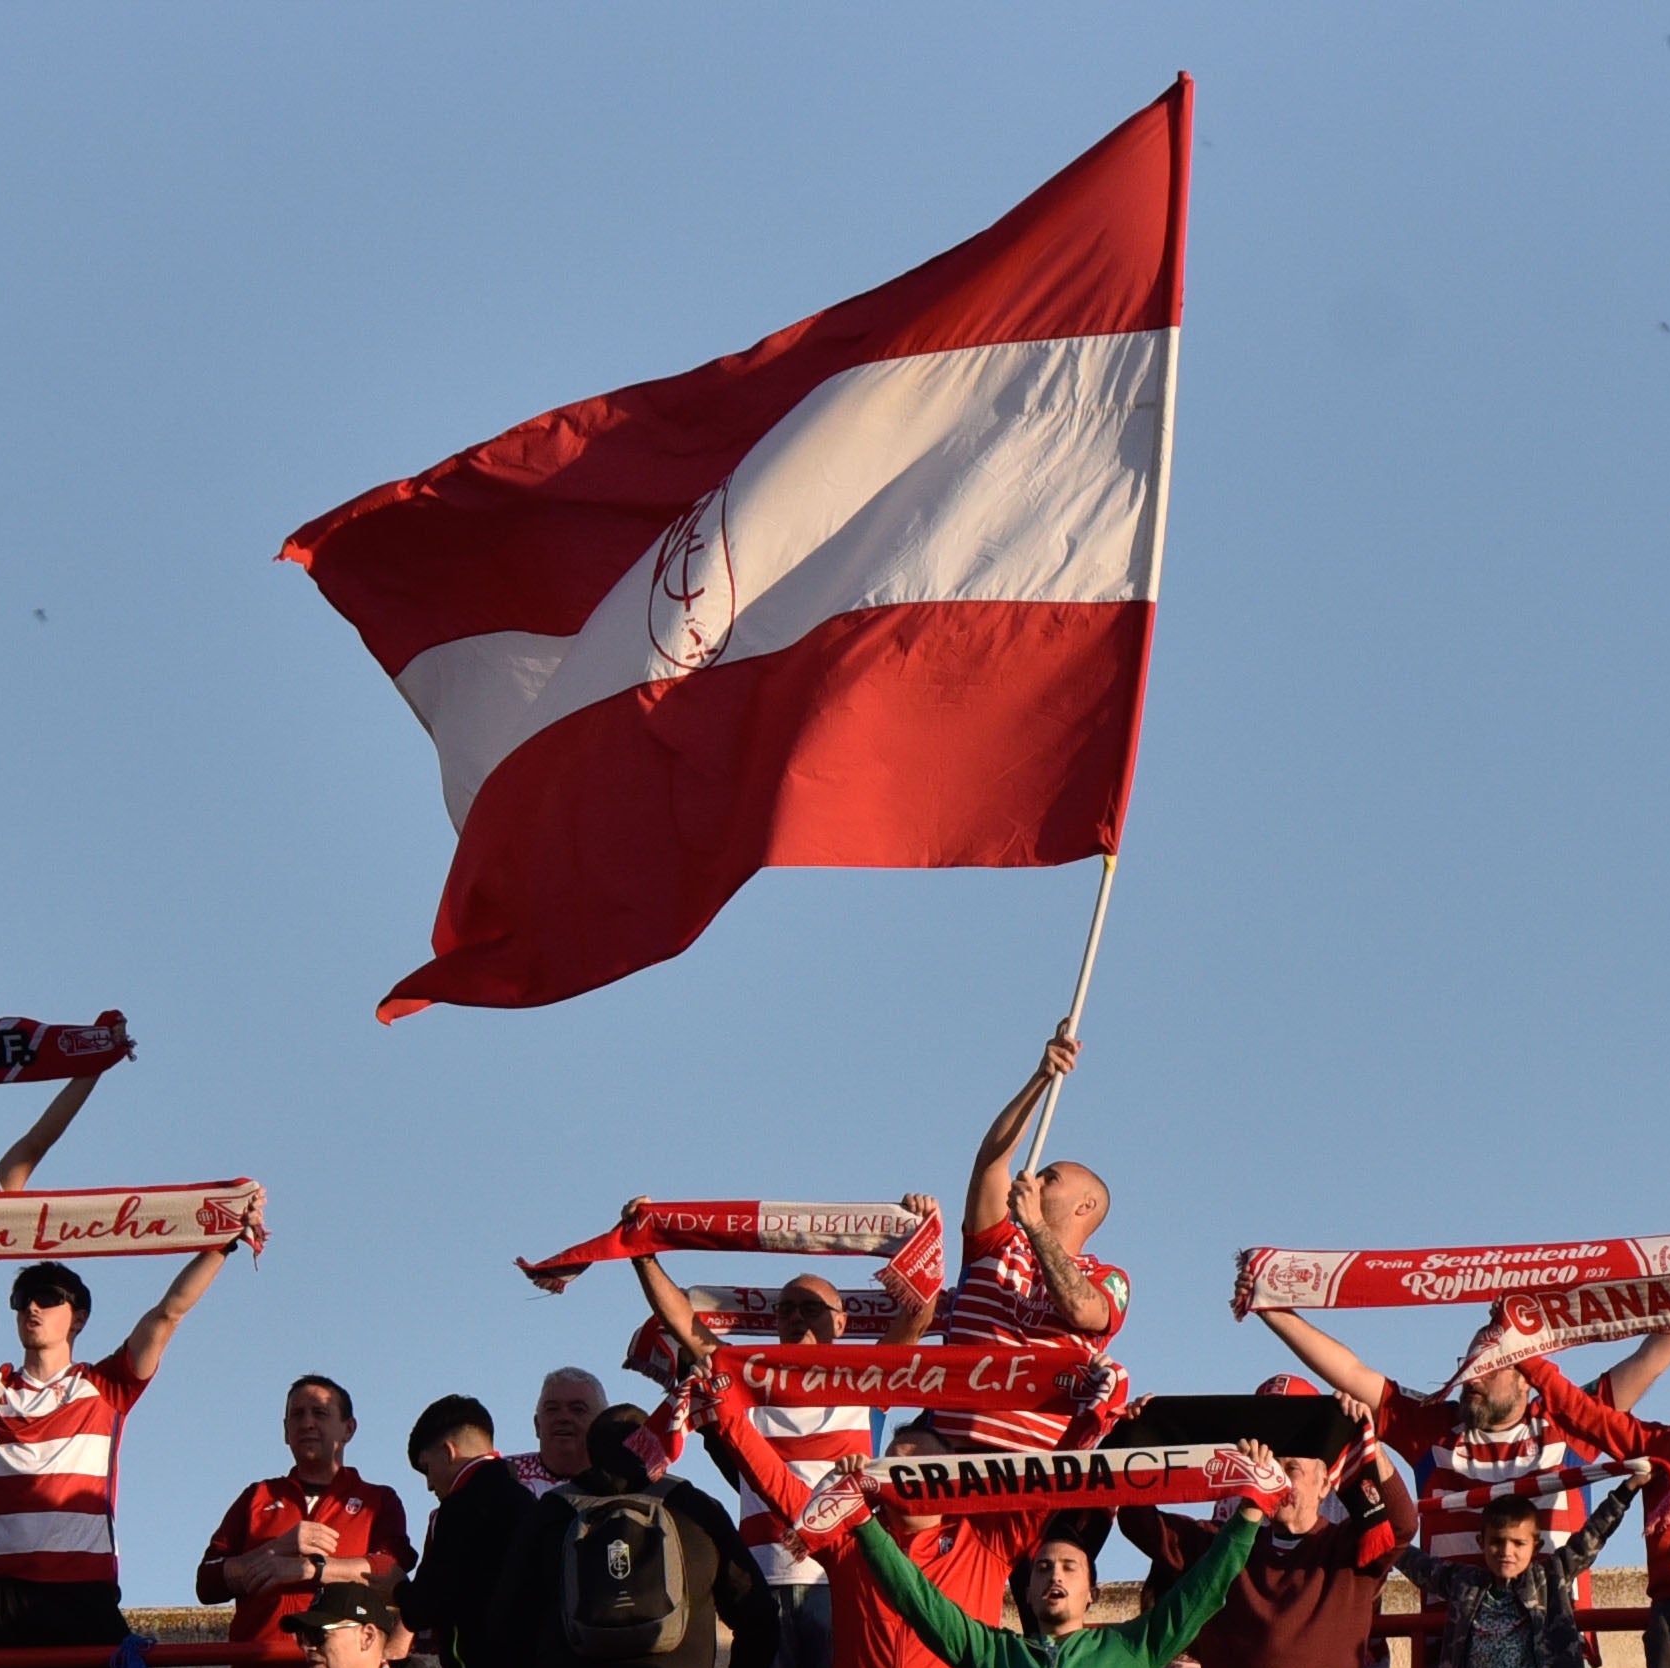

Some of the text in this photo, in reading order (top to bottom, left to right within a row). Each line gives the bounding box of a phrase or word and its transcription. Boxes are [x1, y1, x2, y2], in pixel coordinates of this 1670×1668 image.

[33, 1196, 178, 1250] Lucha
[1421, 1243, 1608, 1271] Sentimiento
[1401, 1264, 1579, 1300] Rojiblanco
[743, 1353, 1038, 1395] Granada C.F.
